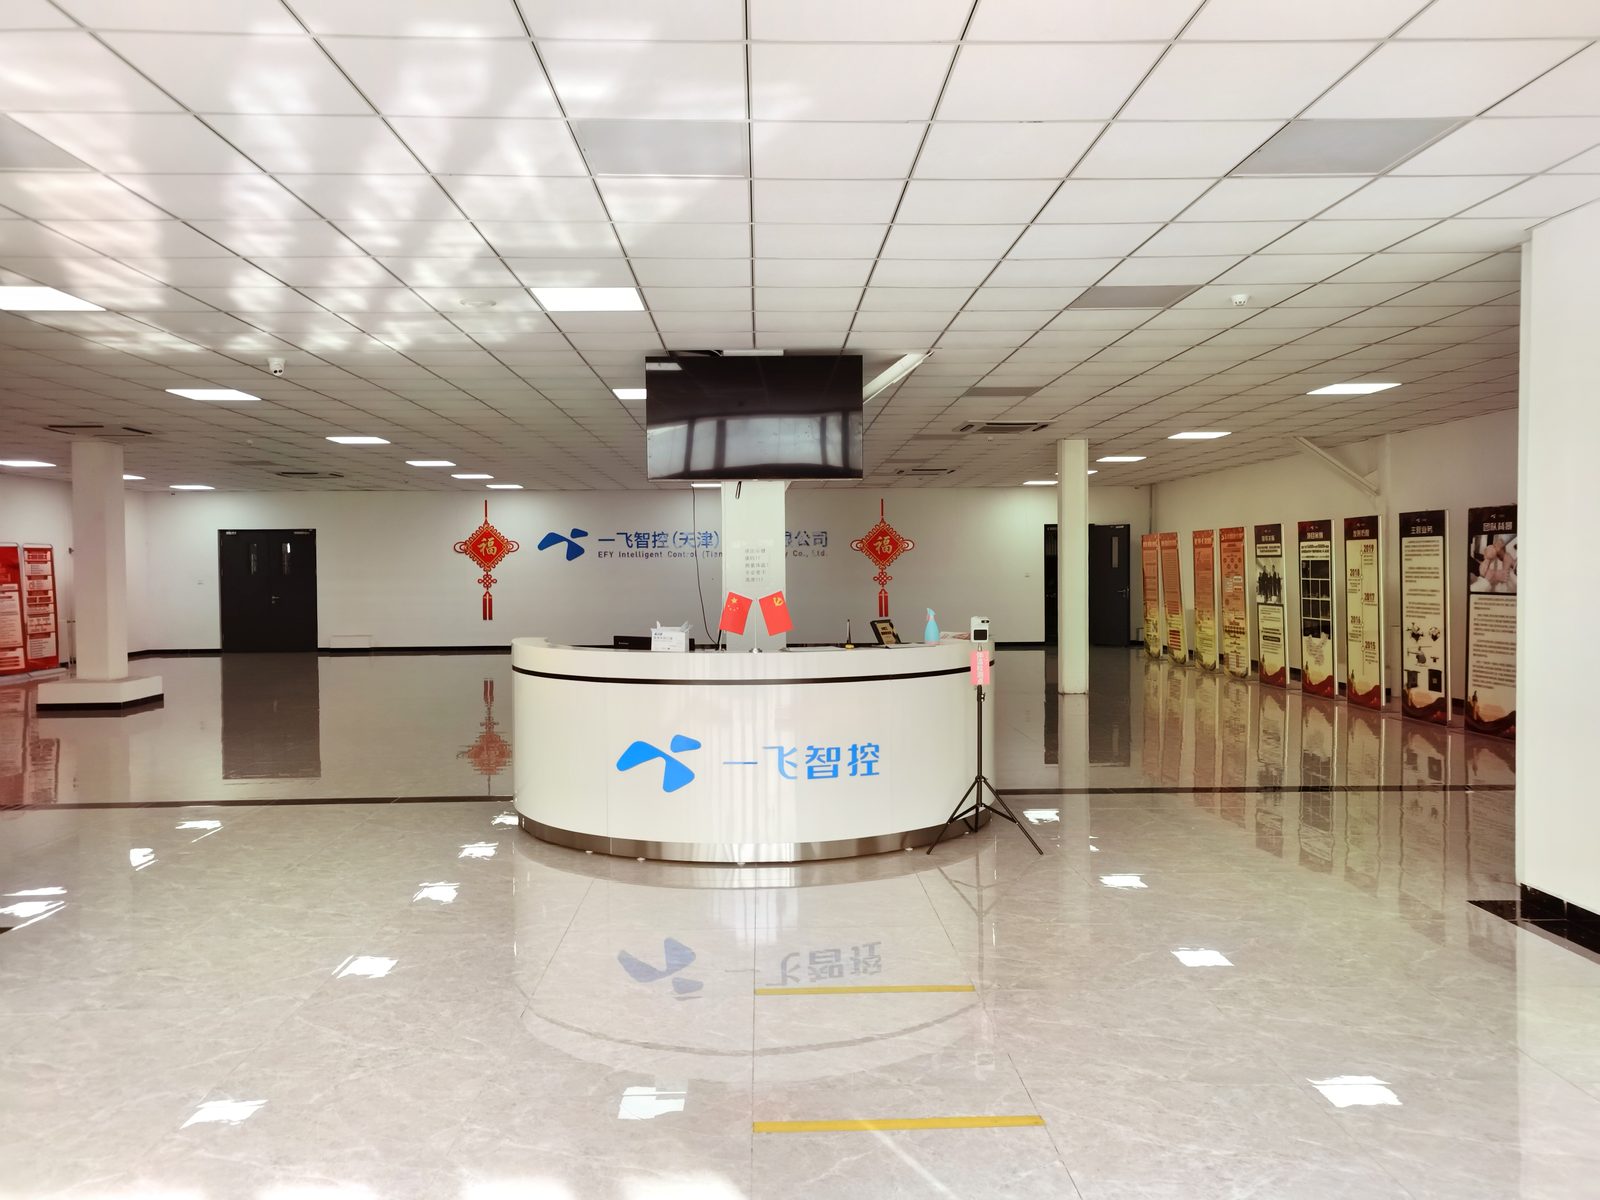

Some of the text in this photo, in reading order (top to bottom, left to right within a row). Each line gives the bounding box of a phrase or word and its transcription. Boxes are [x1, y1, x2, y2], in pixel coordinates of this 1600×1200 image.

[477, 537, 497, 556] 福
[873, 536, 893, 554] 福
[598, 550, 614, 558] EFY
[618, 550, 663, 559] Intelligent
[722, 742, 880, 780] 一飞智控
